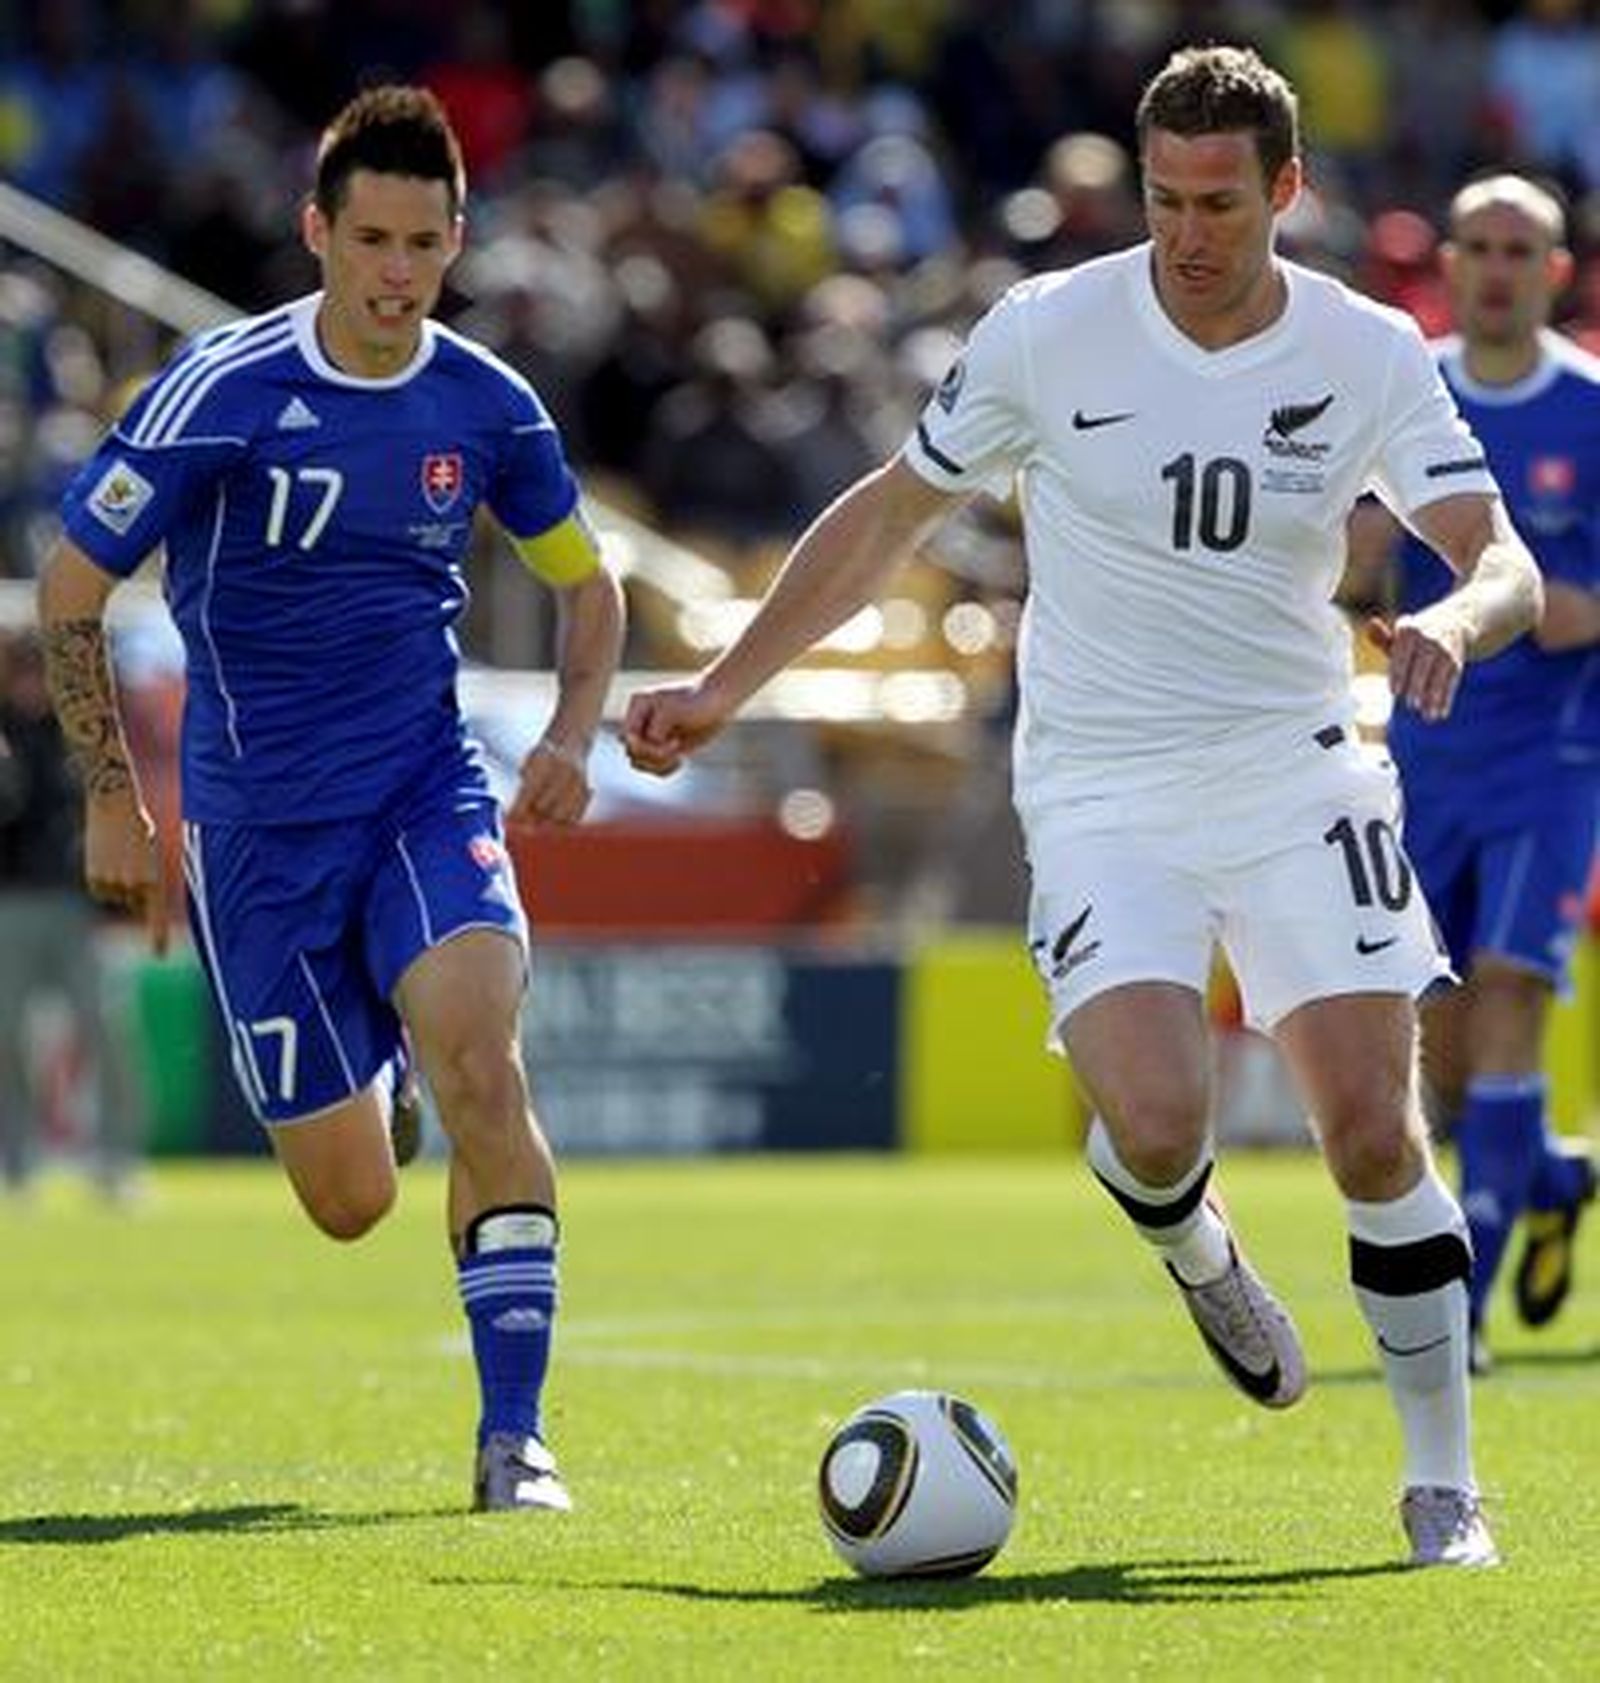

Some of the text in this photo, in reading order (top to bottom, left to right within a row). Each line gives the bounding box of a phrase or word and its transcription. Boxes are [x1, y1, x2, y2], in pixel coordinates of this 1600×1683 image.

[266, 466, 344, 549] 17
[1161, 453, 1251, 553] 10
[1323, 816, 1411, 912] 10
[236, 1016, 297, 1103] 17
